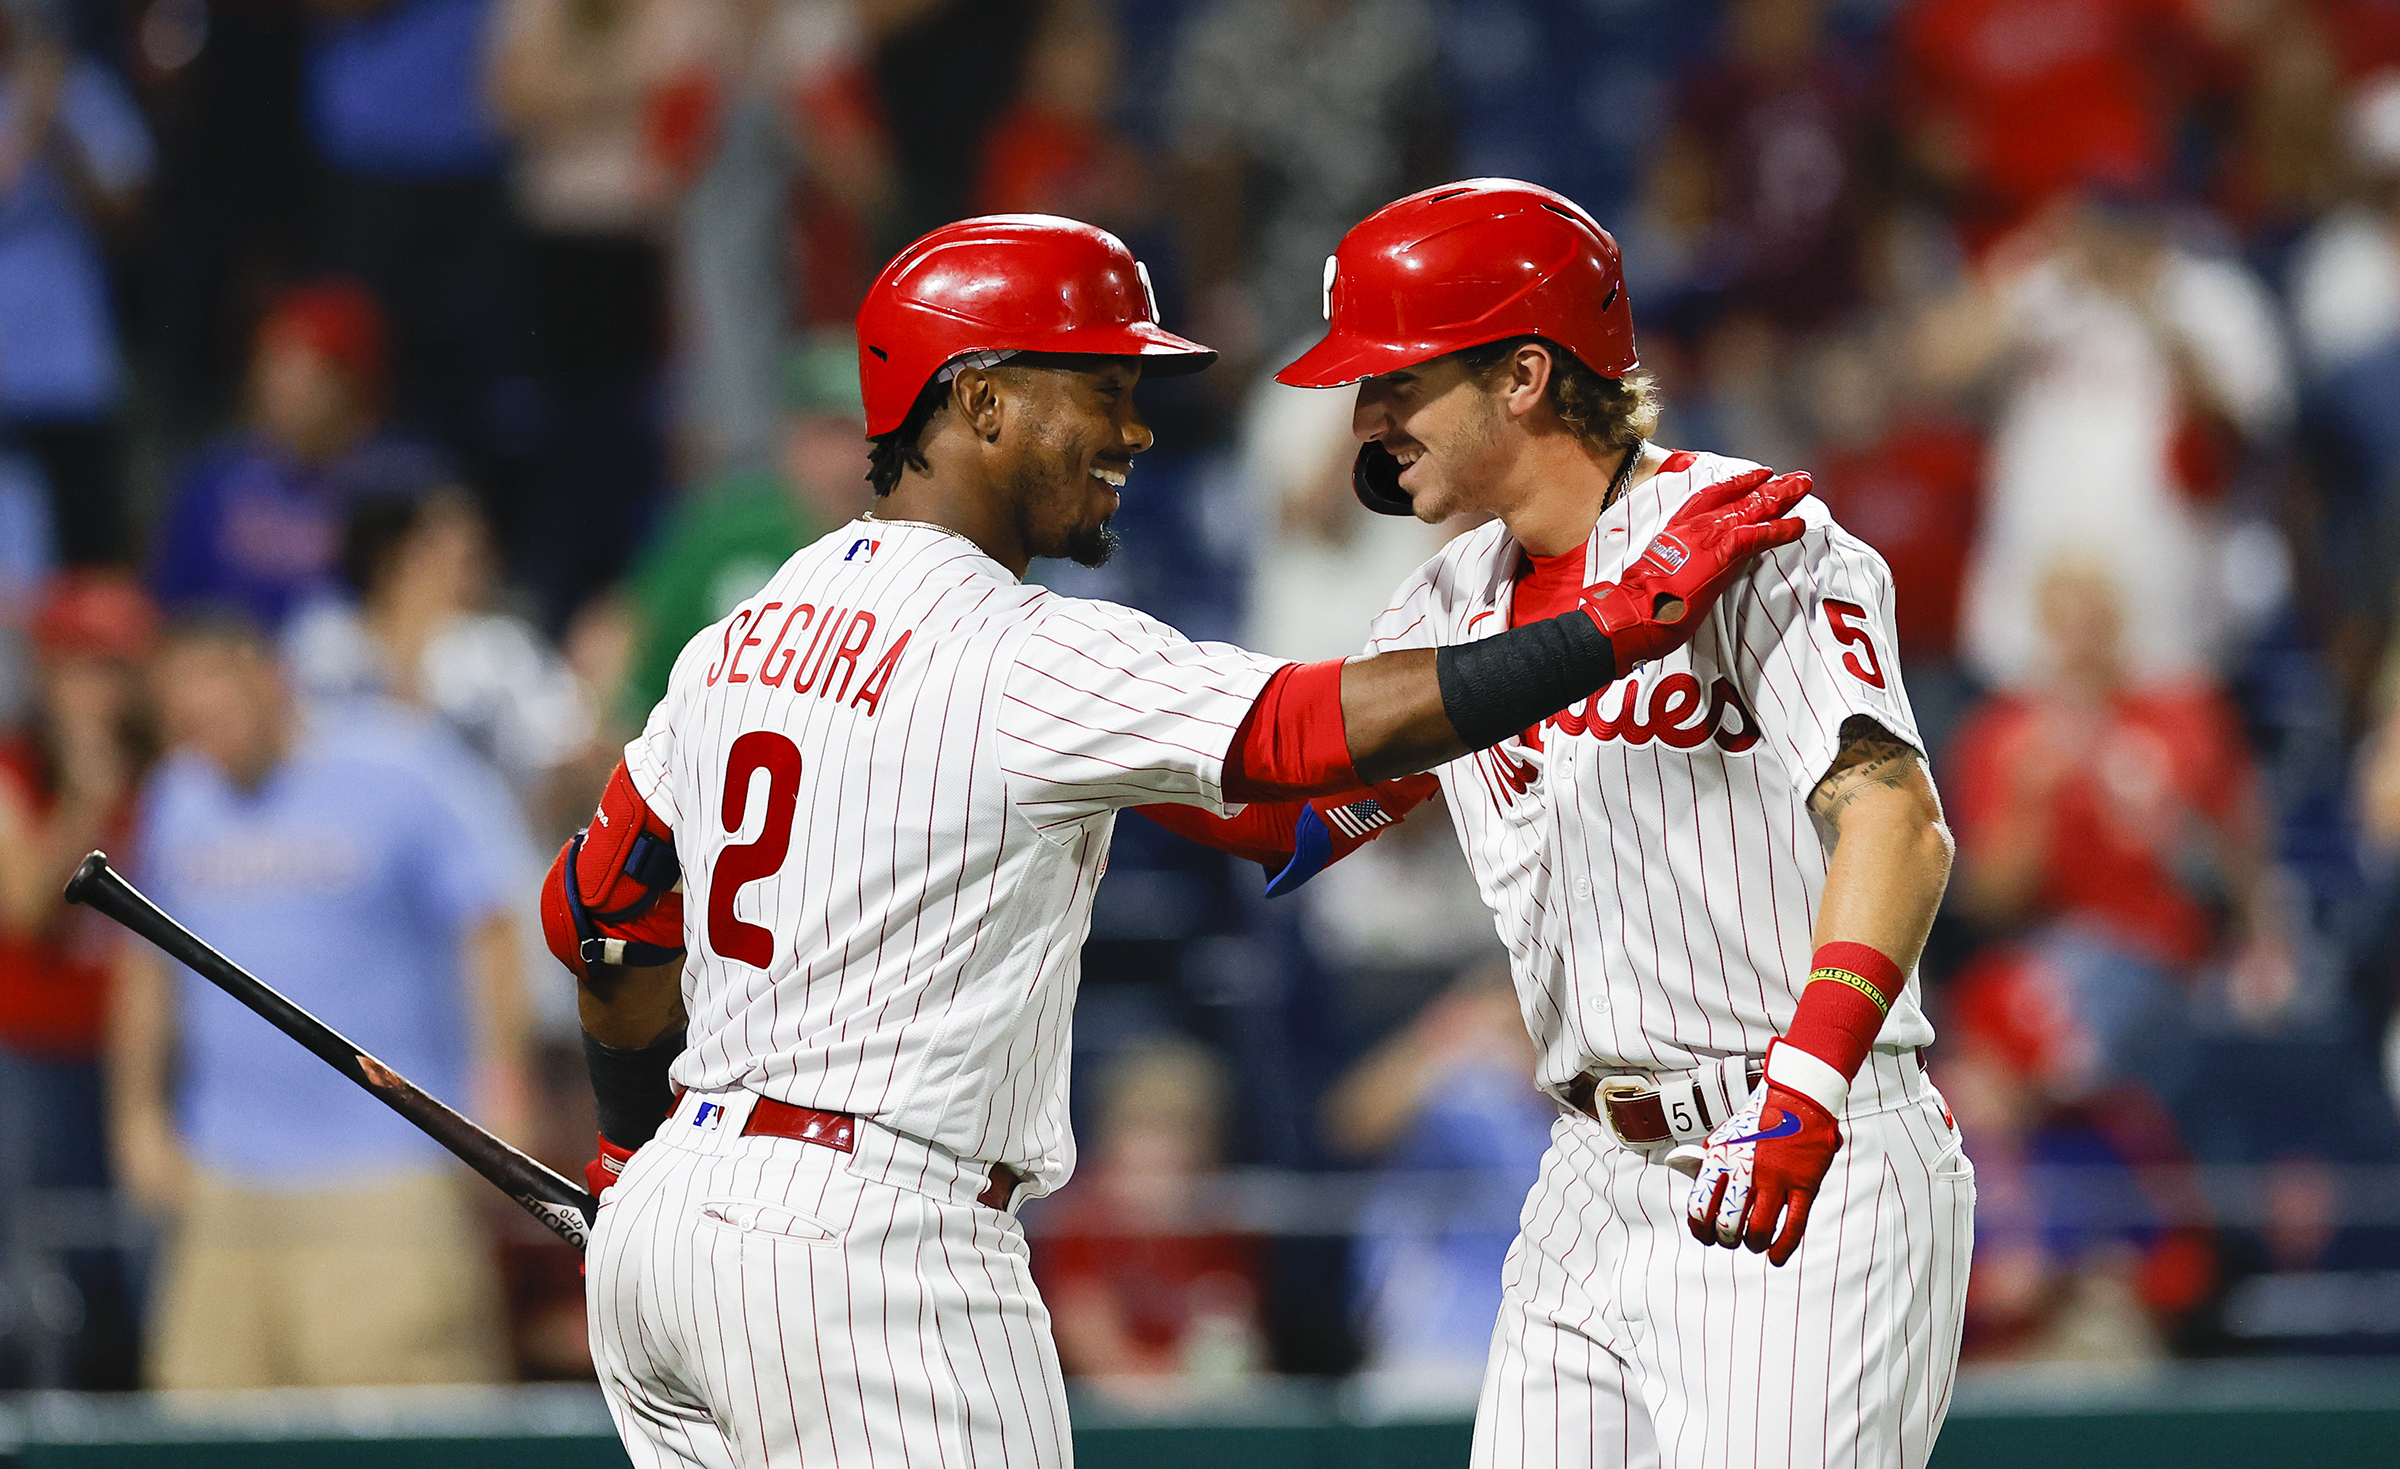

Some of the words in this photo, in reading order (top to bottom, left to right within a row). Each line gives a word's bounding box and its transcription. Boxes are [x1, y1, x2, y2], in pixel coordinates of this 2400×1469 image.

[706, 602, 912, 717] SEGURA
[1822, 598, 1886, 690] 5
[708, 731, 802, 969] 2
[1809, 969, 1889, 1014] WARRIORSTRO
[1672, 1102, 1693, 1132] 5
[521, 1195, 587, 1249] HICKO
[560, 1208, 584, 1230] OLD
